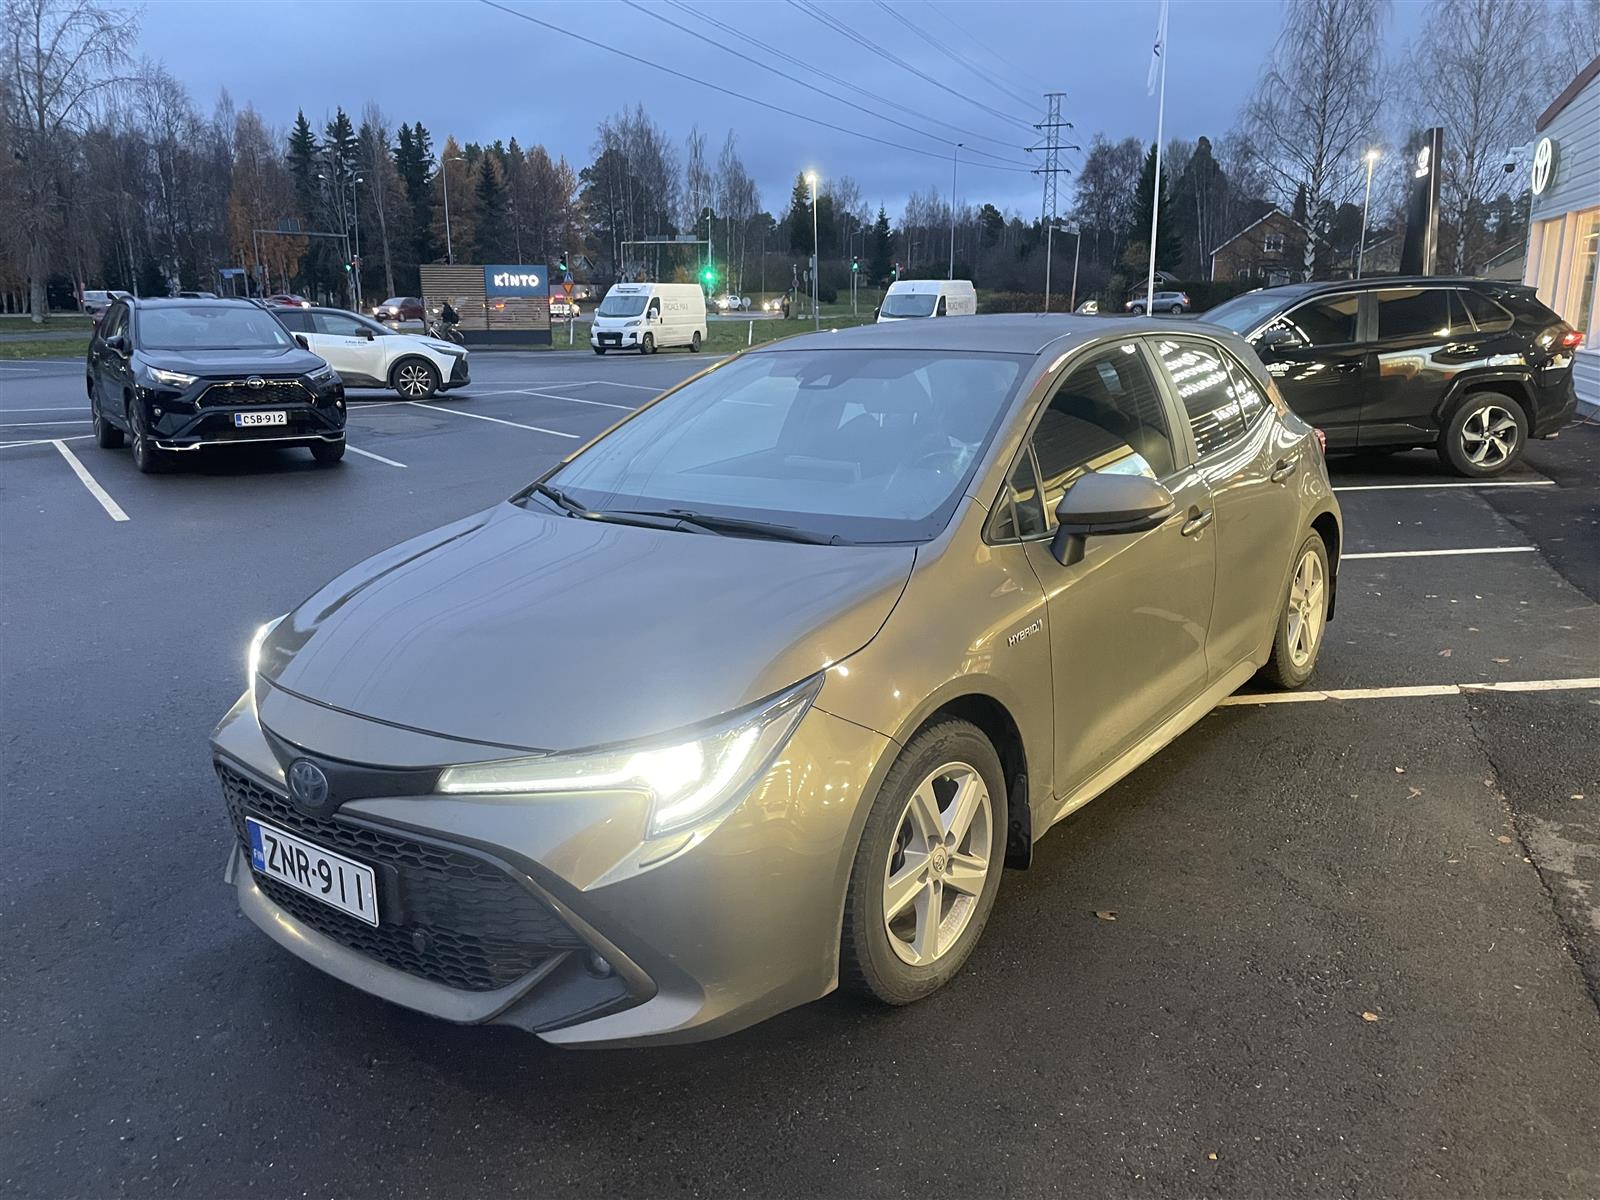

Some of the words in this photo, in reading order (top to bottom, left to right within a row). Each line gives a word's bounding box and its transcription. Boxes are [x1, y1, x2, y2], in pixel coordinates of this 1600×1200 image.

[493, 272, 540, 287] KINTO
[243, 414, 284, 424] CSB-912
[1007, 623, 1039, 647] HYBRID
[264, 834, 364, 911] ZNR-911
